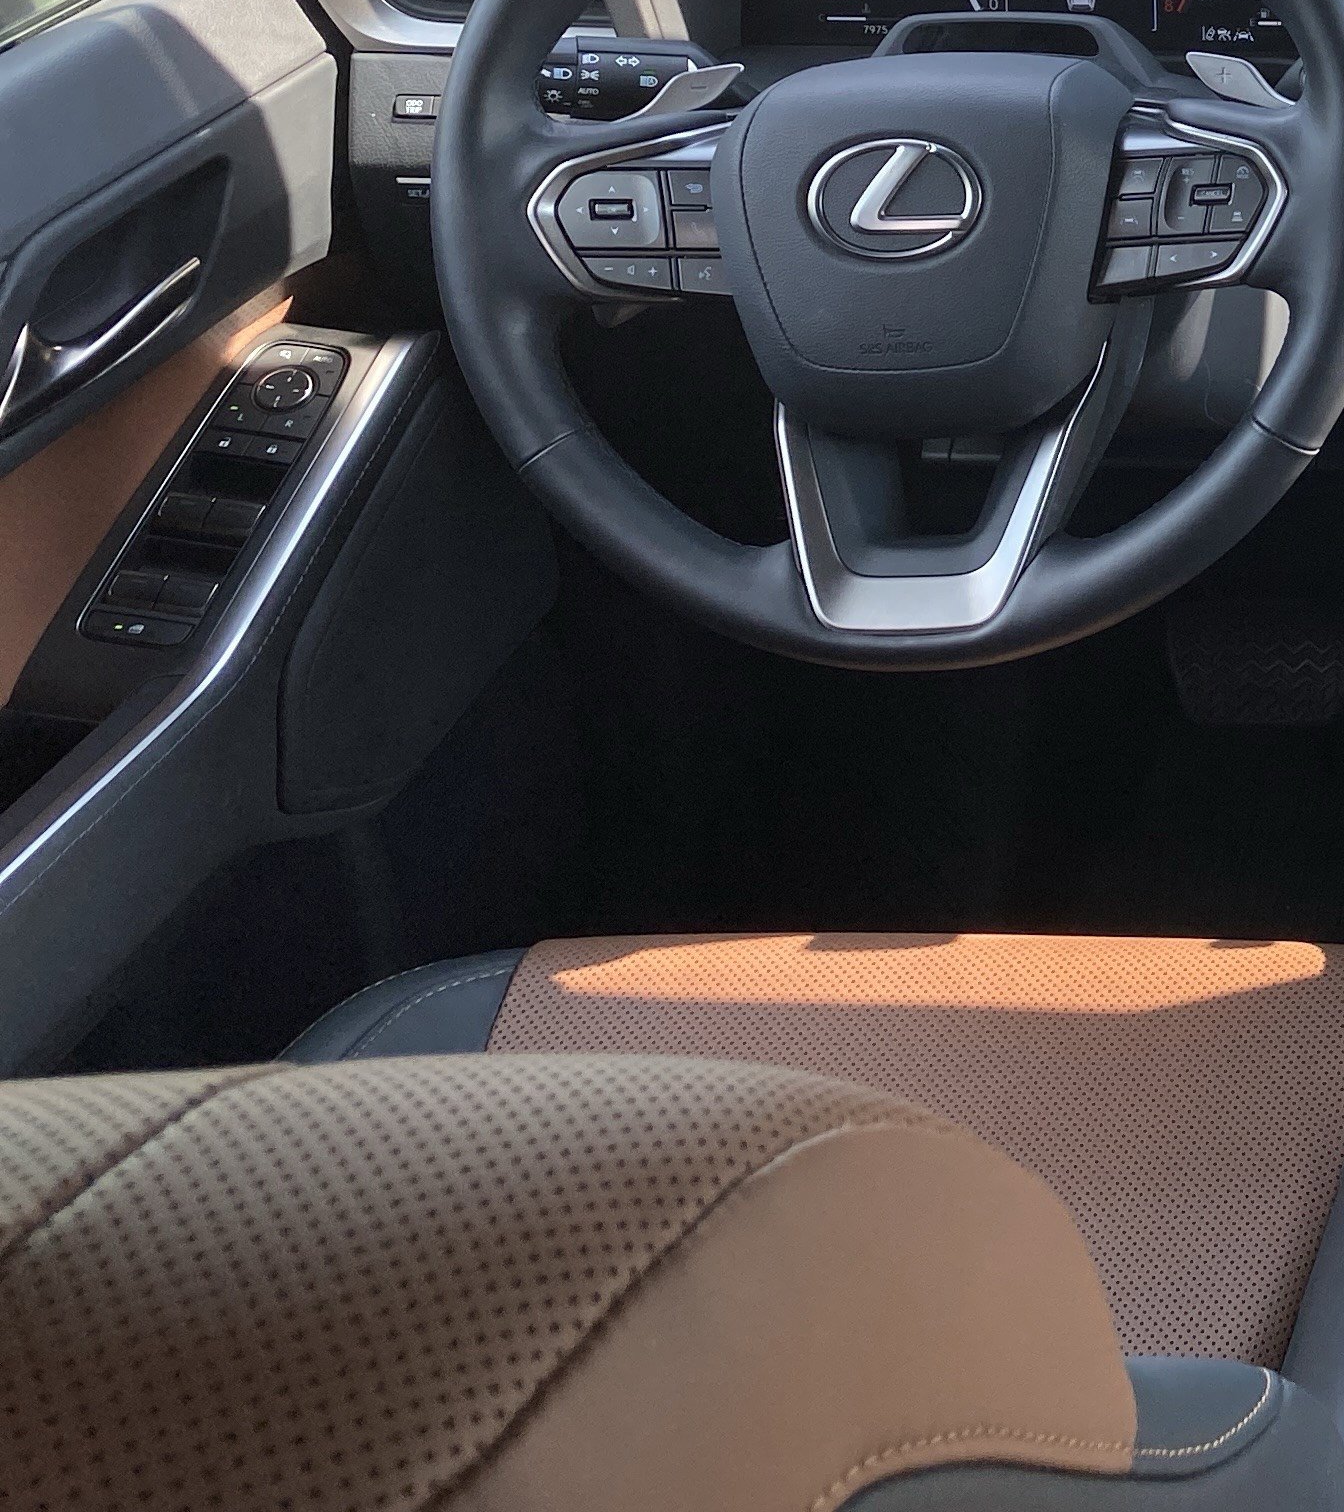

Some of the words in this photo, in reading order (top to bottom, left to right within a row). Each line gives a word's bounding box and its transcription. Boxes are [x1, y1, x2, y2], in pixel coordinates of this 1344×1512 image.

[1164, 0, 1173, 12] 8
[864, 25, 888, 35] 7975
[577, 87, 600, 96] AUTO
[405, 99, 424, 107] ODO
[313, 355, 333, 363] AUTO
[284, 420, 294, 428] R
